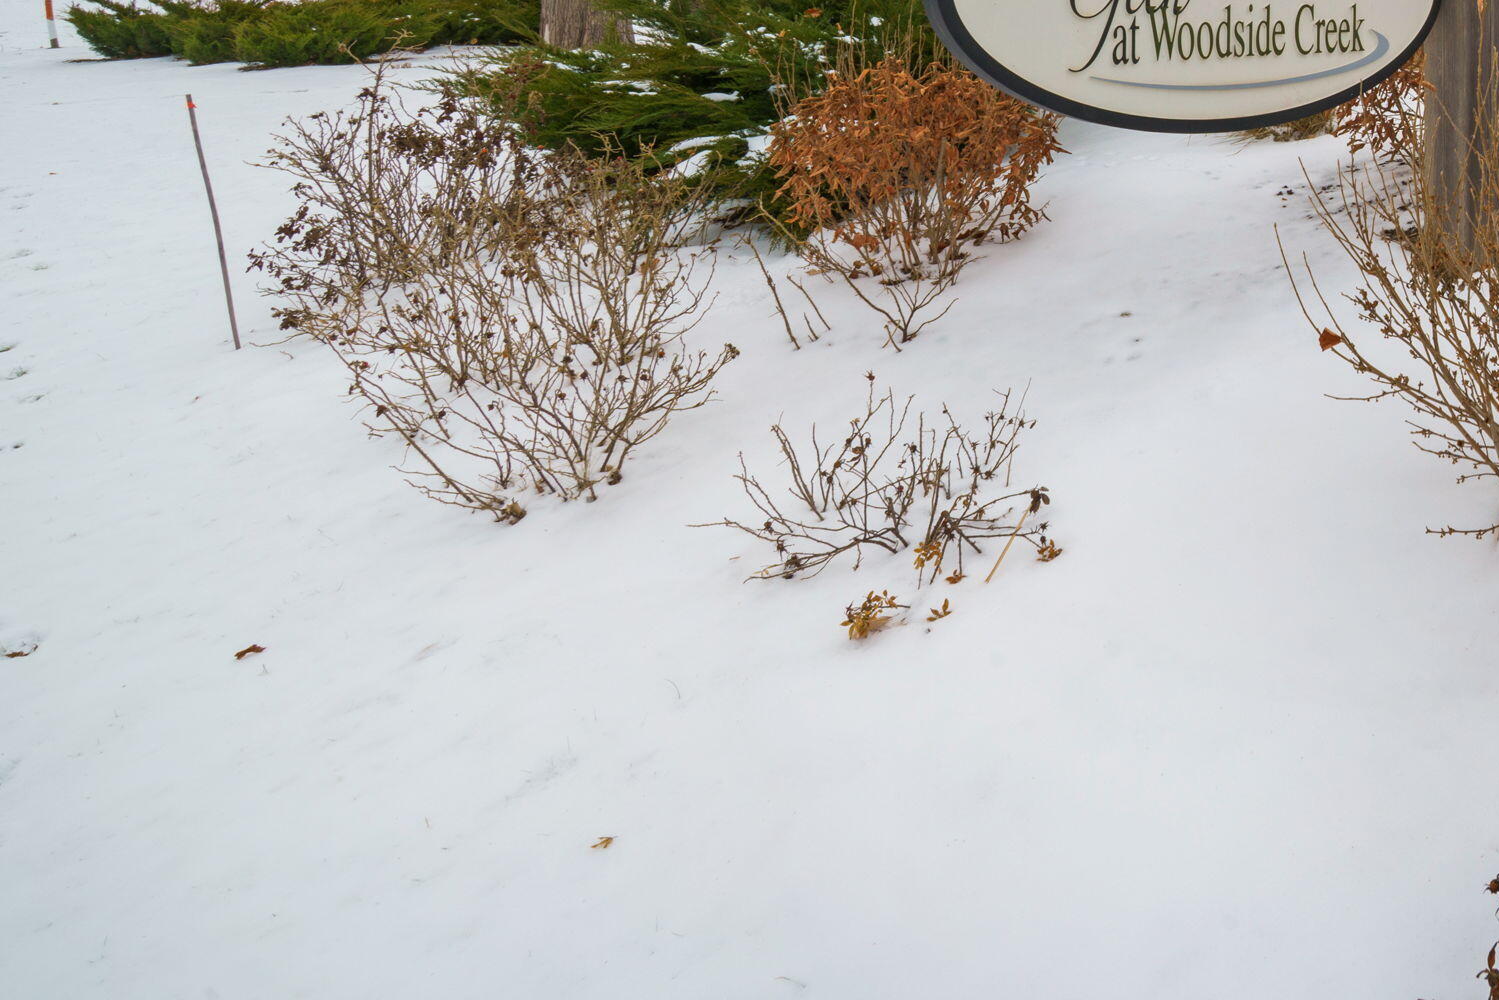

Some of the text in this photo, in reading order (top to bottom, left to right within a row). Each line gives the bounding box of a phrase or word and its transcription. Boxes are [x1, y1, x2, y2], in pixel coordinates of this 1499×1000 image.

[1112, 3, 1365, 65] at Woodside Creek
